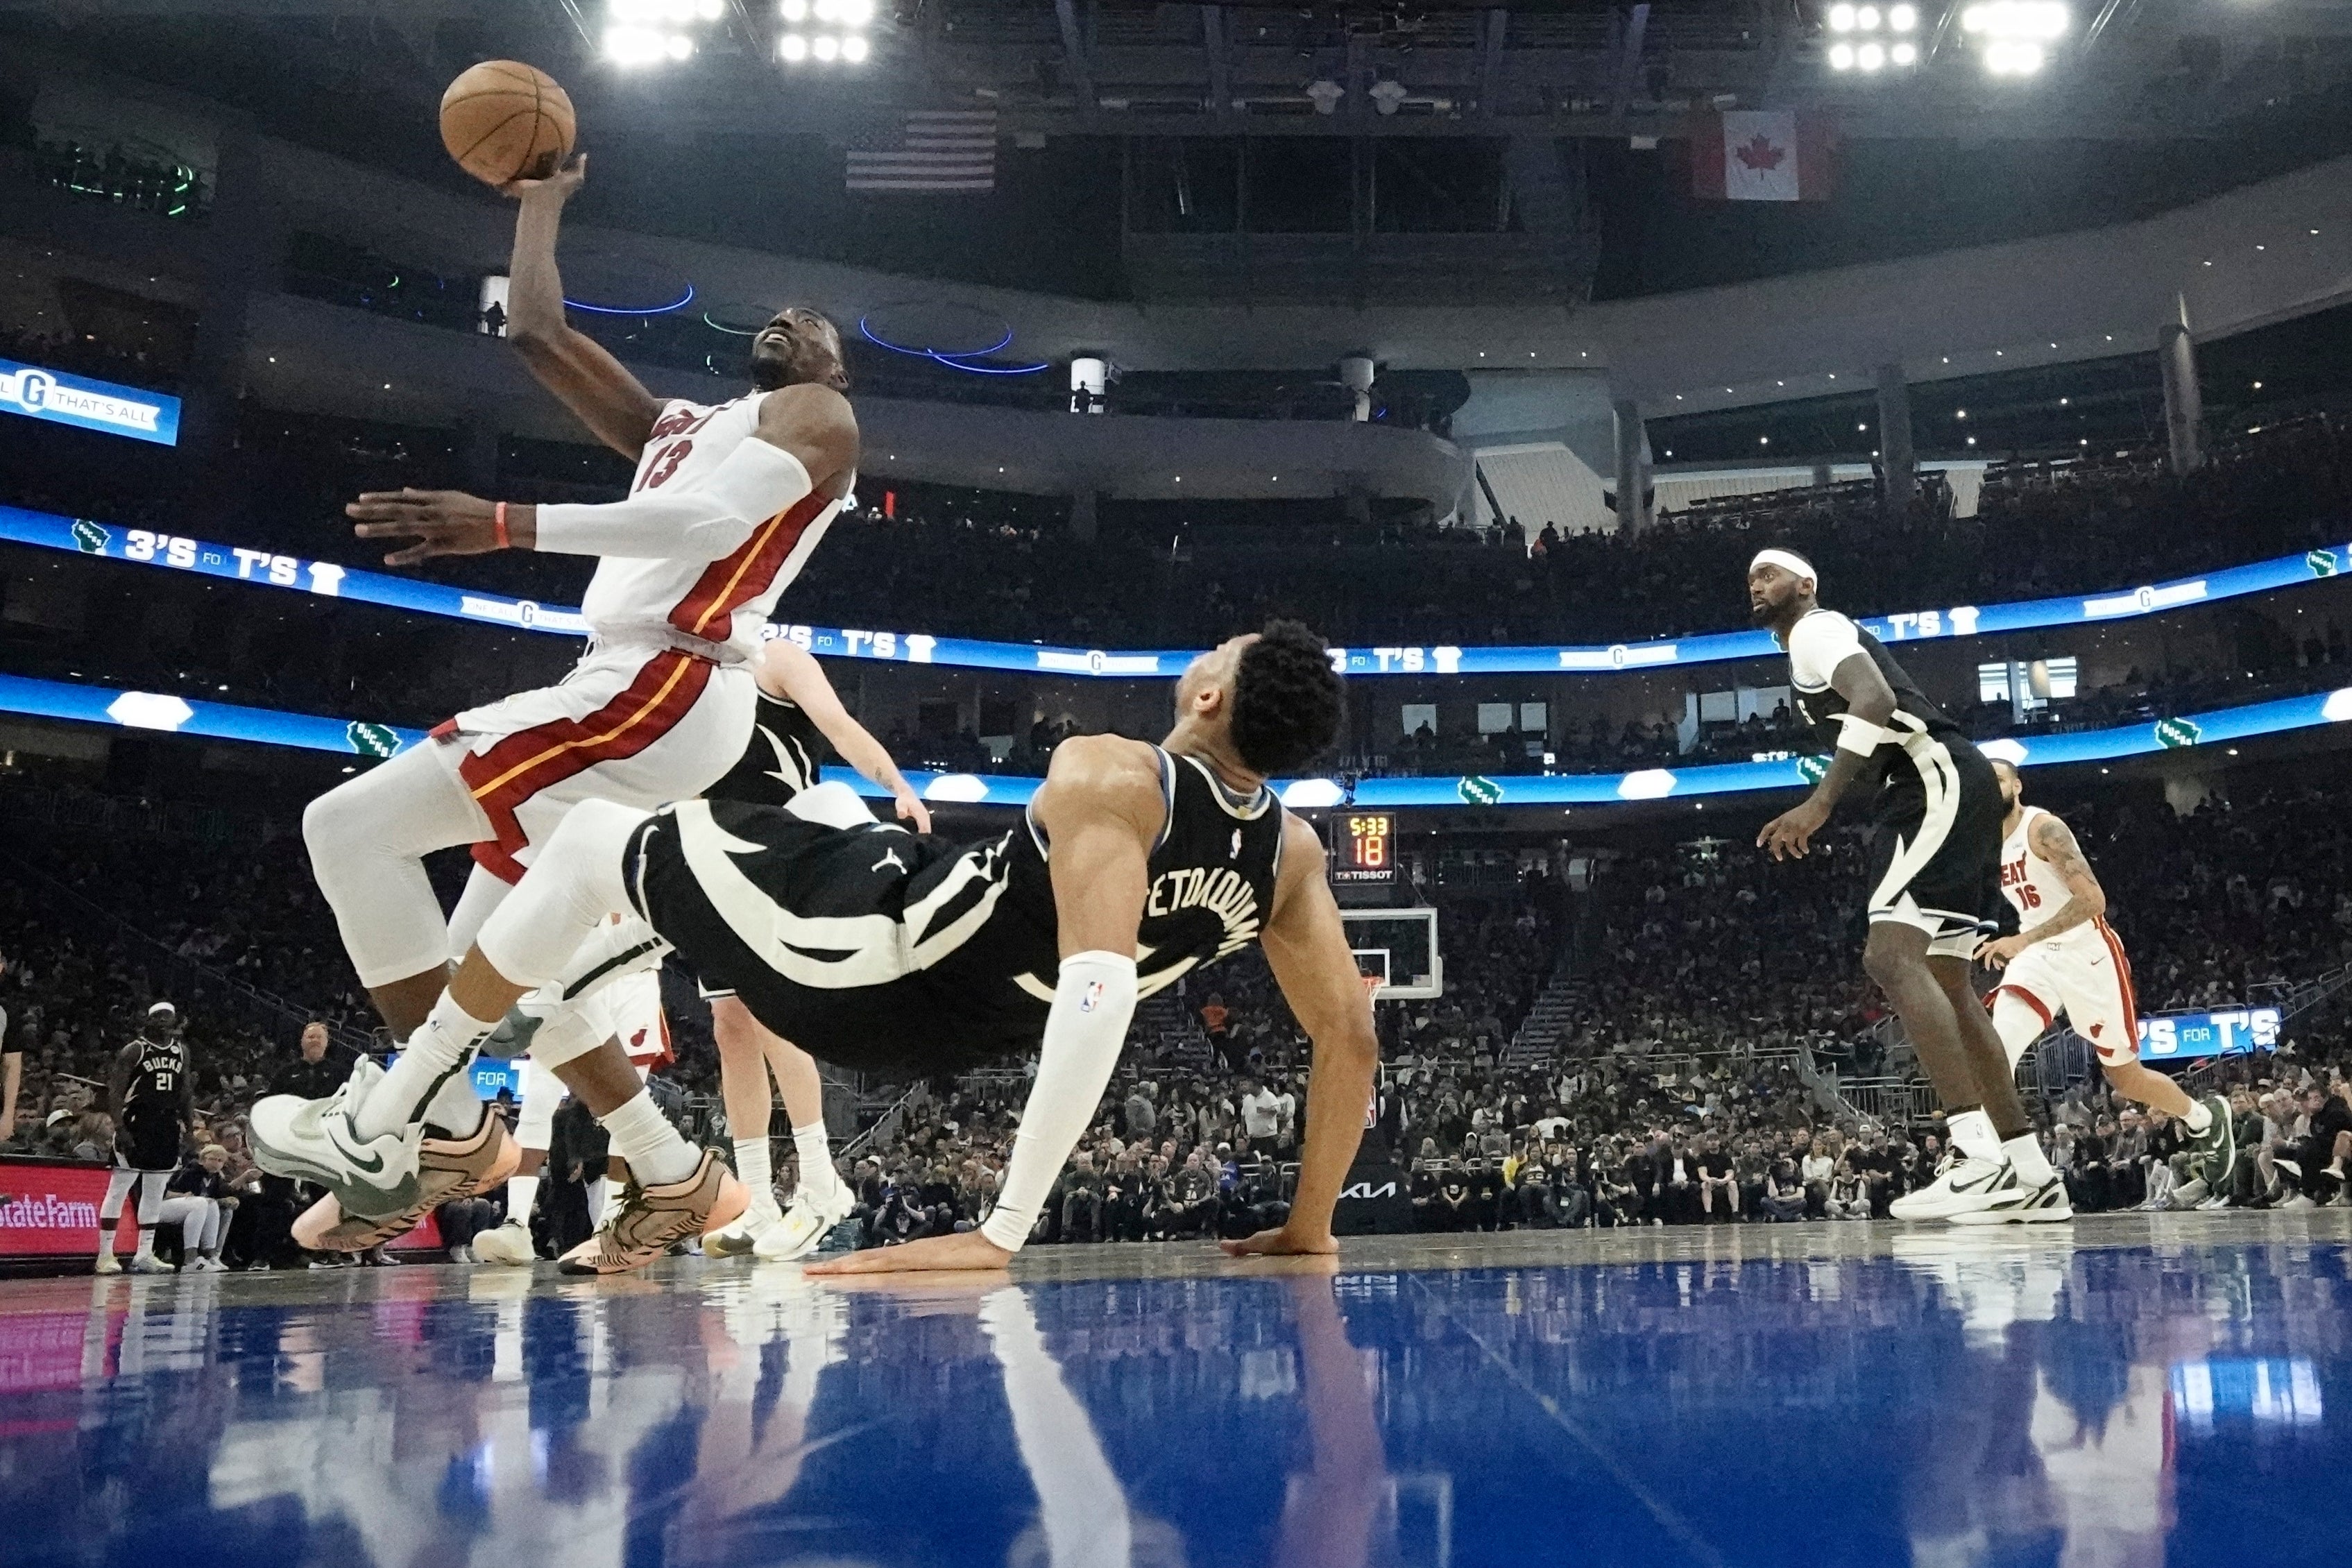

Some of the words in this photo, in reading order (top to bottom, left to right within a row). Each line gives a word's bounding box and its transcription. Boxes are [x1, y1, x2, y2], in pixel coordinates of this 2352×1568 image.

[56, 393, 114, 416] THAT'S
[119, 407, 149, 423] ALL
[634, 440, 693, 493] 13
[78, 524, 103, 547] BUCKS
[125, 530, 197, 569] 3'S
[233, 547, 298, 586] T'S
[1887, 611, 1941, 640] T'S
[842, 629, 896, 658] T'S
[1373, 647, 1424, 672] T'S
[357, 723, 389, 758] BUCKS
[1349, 817, 1388, 837] 5:33
[1356, 836, 1383, 866] 18
[1351, 871, 1393, 880] TISSOT
[2015, 885, 2042, 911] 16
[2138, 1019, 2178, 1055] 'S
[2183, 1027, 2211, 1042] FOR
[2210, 1009, 2281, 1049] T'S
[142, 1056, 183, 1074] BUCKS
[477, 1071, 506, 1086] FOR
[156, 1072, 173, 1091] 21
